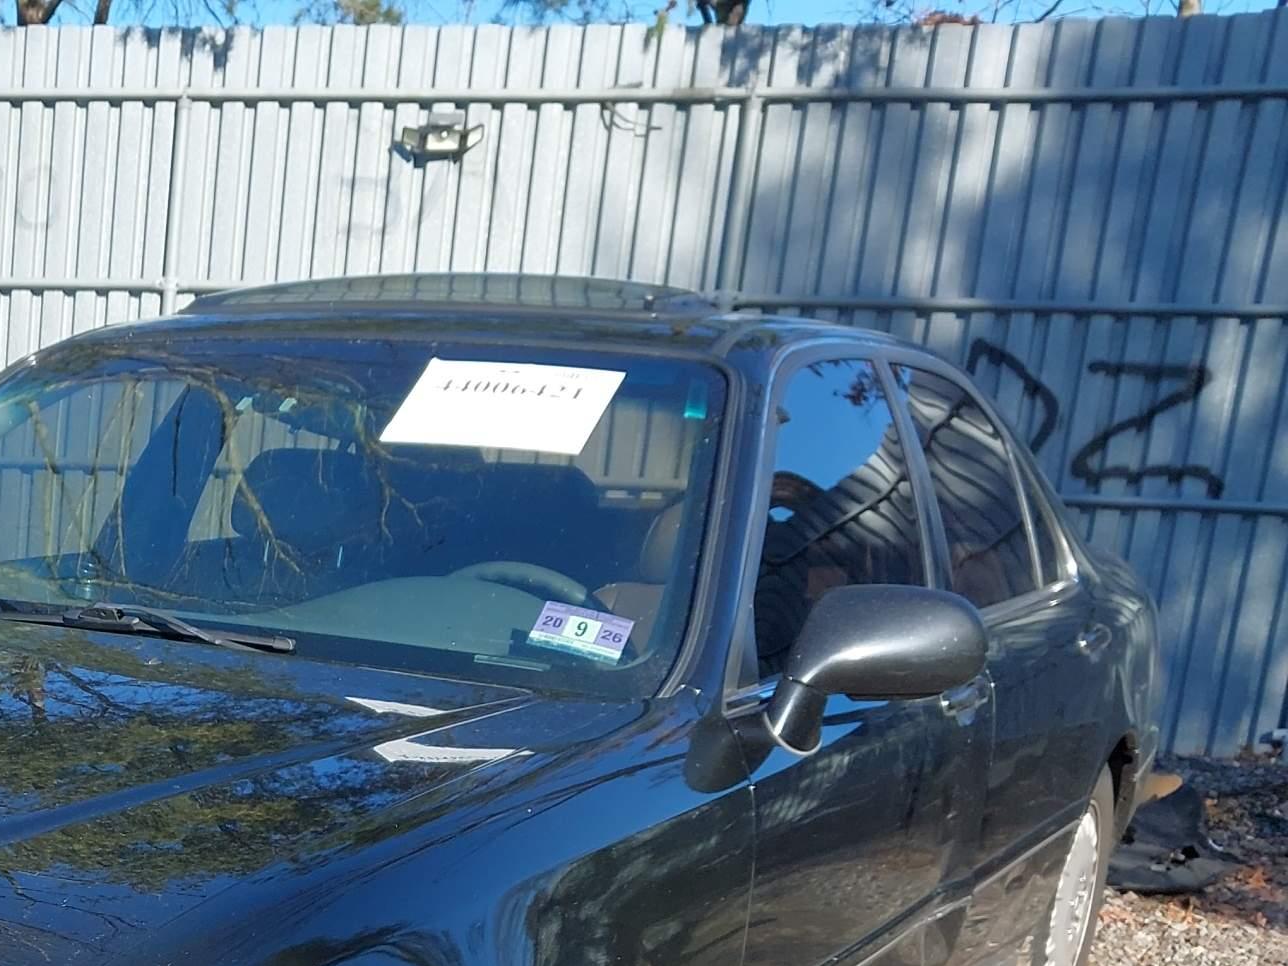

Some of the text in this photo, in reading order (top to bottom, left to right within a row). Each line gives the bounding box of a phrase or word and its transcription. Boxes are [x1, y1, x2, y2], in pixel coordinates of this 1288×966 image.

[542, 615, 623, 644] 20 9 26
